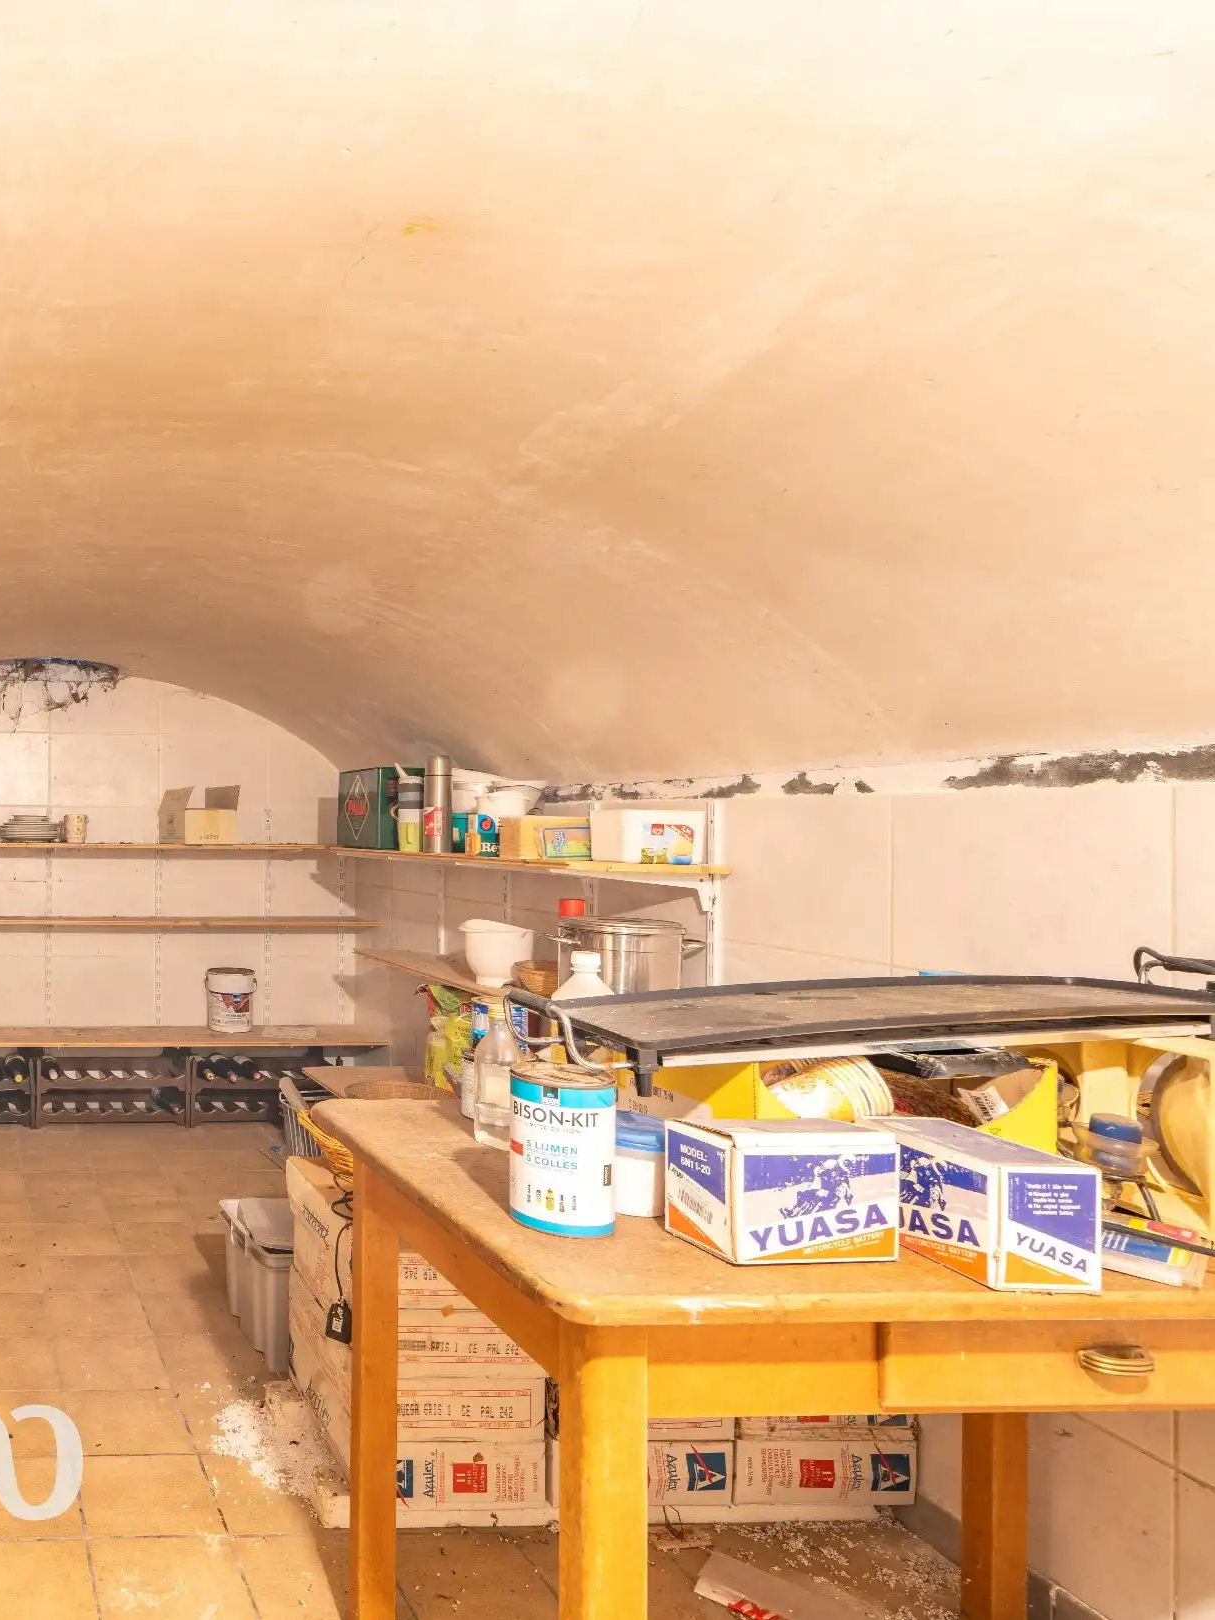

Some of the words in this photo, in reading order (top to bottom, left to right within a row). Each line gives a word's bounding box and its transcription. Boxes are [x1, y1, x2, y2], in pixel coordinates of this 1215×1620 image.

[513, 1100, 599, 1128] BISON-KIT
[526, 1139, 532, 1147] 5
[534, 1141, 578, 1155] LIJMEN
[534, 1156, 578, 1170] COLLES
[680, 1143, 708, 1162] MODEL:
[748, 1203, 889, 1252] YUASA
[803, 1239, 853, 1255] MOTORCYCLE
[853, 1231, 885, 1244] BATTERY
[899, 1206, 981, 1248] ASA
[948, 1245, 978, 1259] BATTERY
[1015, 1231, 1087, 1274] YUASA
[422, 1459, 434, 1498] Azuley
[666, 1453, 681, 1492] Azuley
[852, 1453, 865, 1492] Azuley
